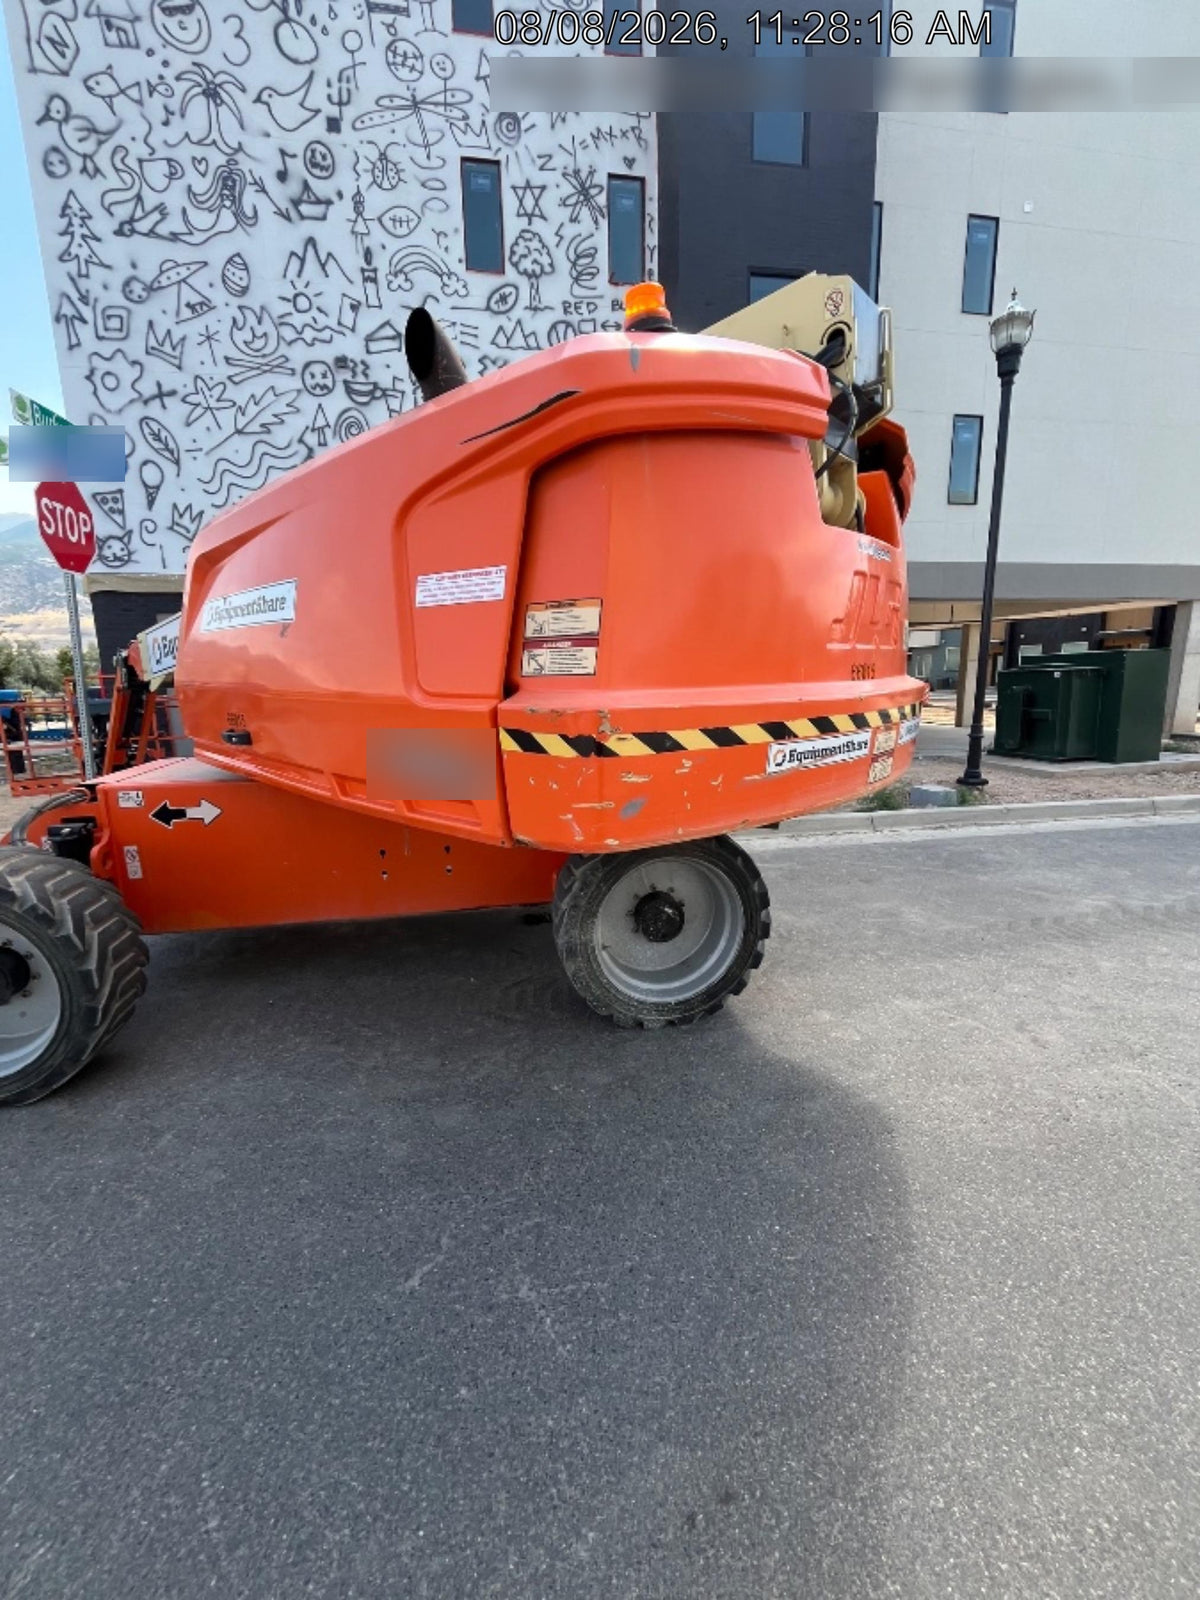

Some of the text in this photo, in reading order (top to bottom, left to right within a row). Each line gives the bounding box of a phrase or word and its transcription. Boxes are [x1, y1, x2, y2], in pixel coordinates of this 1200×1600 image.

[561, 300, 599, 316] RED
[40, 497, 91, 545] STOP
[787, 738, 869, 764] EquipmentShare
